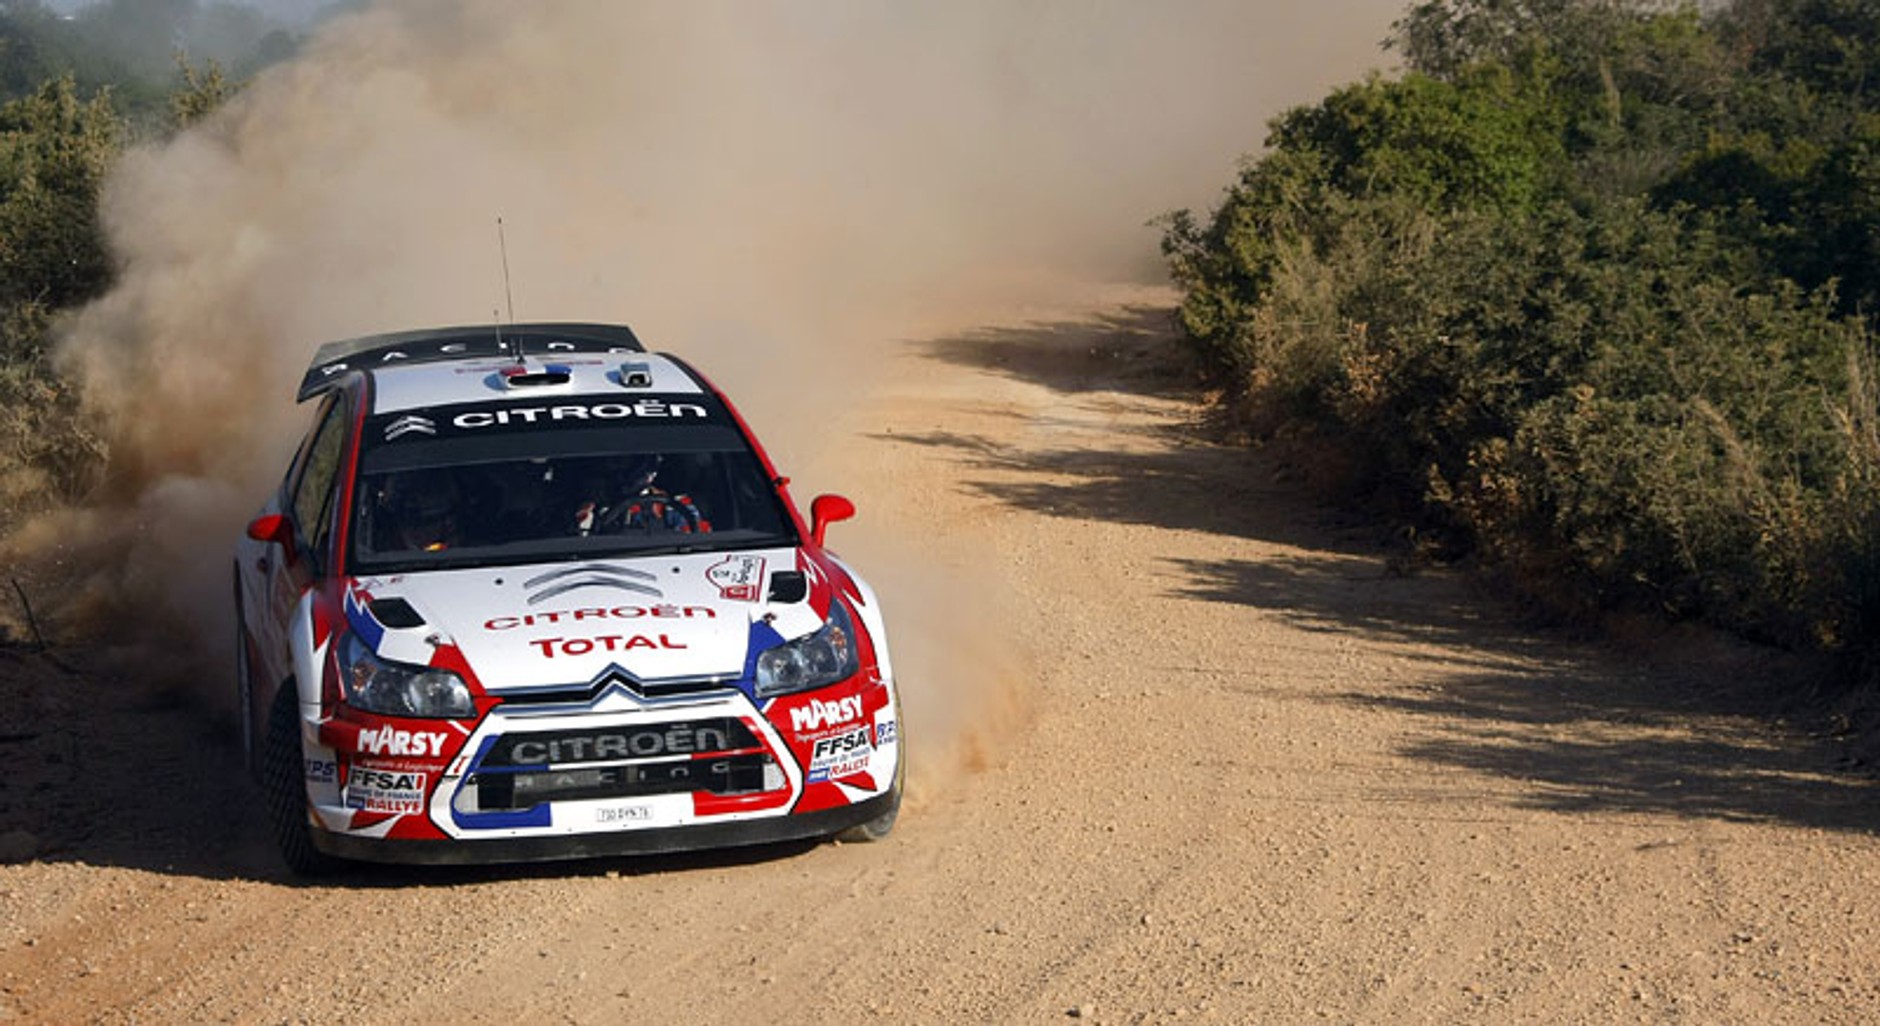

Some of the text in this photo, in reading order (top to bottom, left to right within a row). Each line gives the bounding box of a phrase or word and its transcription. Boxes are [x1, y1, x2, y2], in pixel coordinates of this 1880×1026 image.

[453, 399, 707, 428] CITROËN
[483, 603, 716, 631] CITROËN
[529, 634, 688, 659] TOTAL
[789, 694, 863, 732] MARSY
[357, 724, 449, 757] MARSY
[511, 724, 727, 764] CITROËN
[815, 730, 867, 758] FFSA
[350, 769, 414, 791] FFSA
[366, 798, 420, 812] RALLYE
